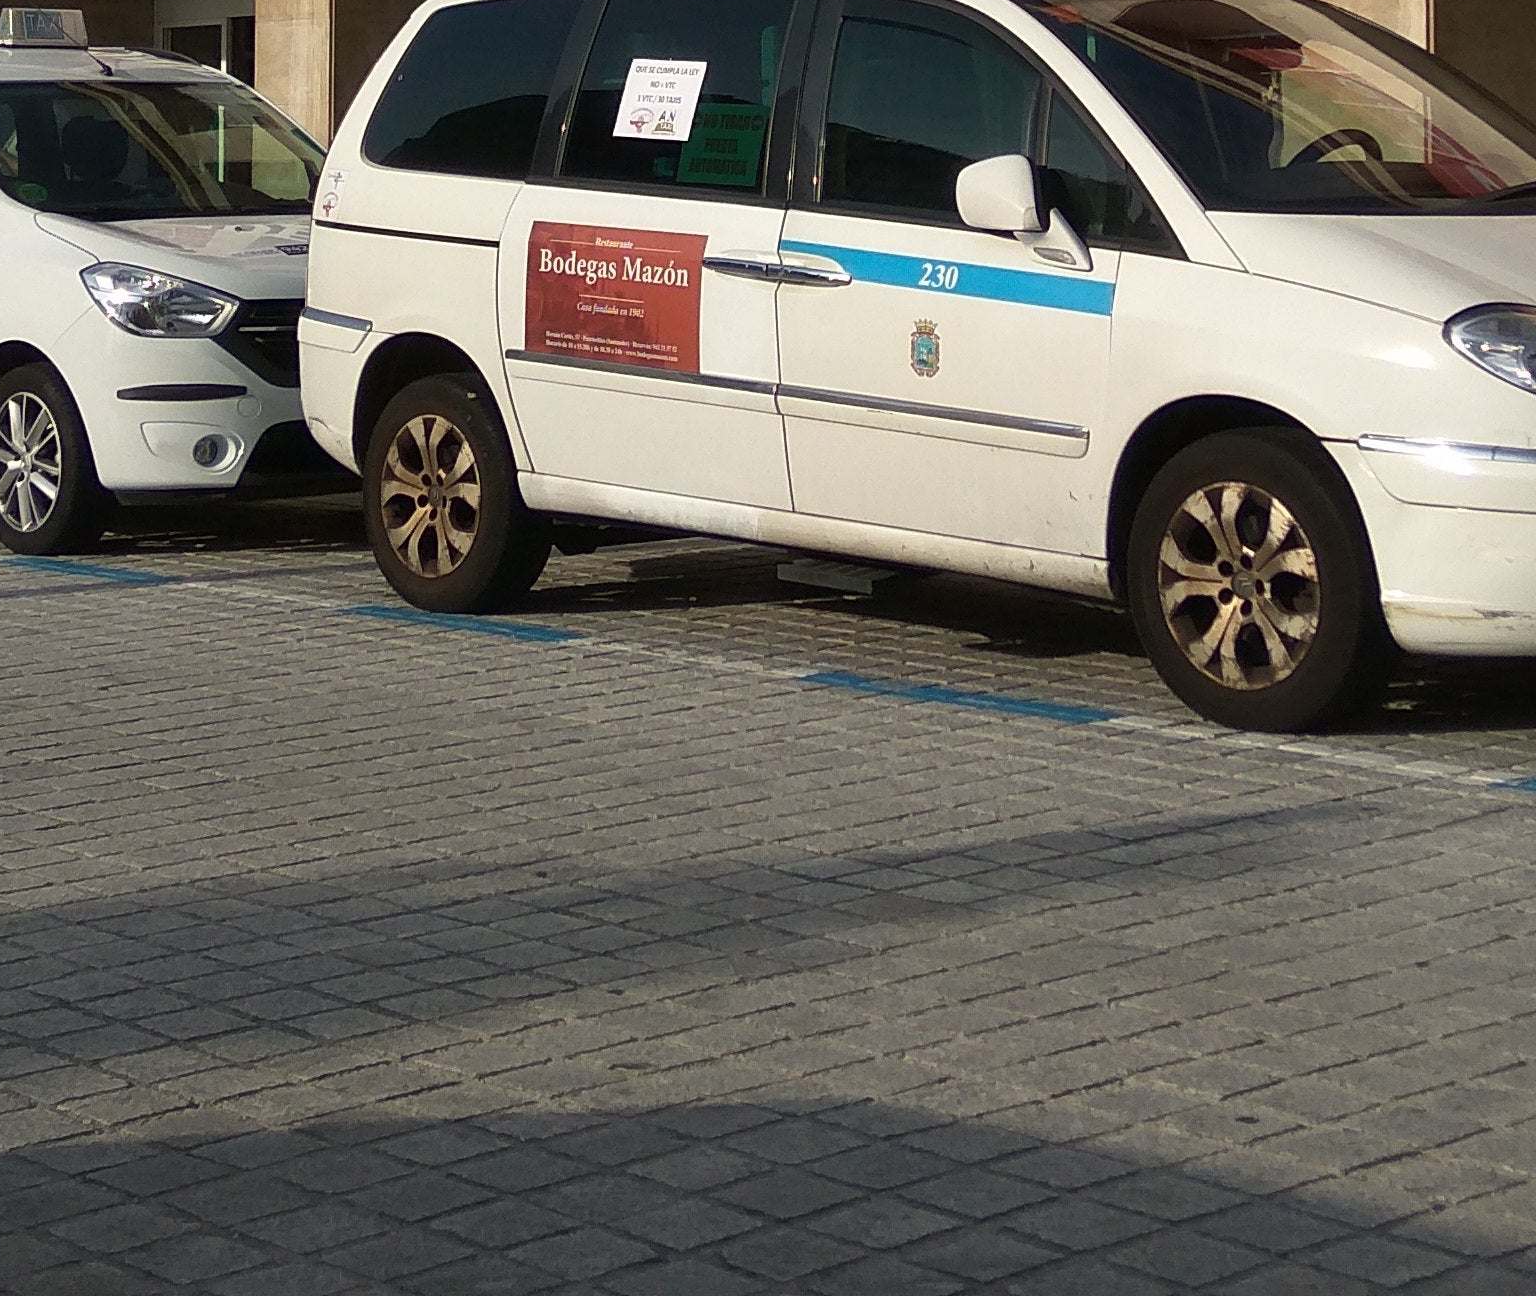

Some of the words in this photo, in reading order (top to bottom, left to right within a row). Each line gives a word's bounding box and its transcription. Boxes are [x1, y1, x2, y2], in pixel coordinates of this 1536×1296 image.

[26, 14, 62, 33] TAXI
[635, 65, 648, 74] QUE
[648, 66, 656, 74] SE
[656, 66, 680, 75] CUMPLA
[681, 67, 689, 75] LA
[689, 68, 700, 76] LEY
[650, 81, 659, 89] NO
[664, 81, 677, 89] VTC
[595, 237, 634, 249] Restaurante
[539, 248, 617, 284] Bodegas
[622, 256, 689, 287] Mazón
[919, 262, 959, 290] 230
[576, 301, 592, 312] Casa
[592, 303, 619, 315] fundada
[620, 308, 628, 316] en
